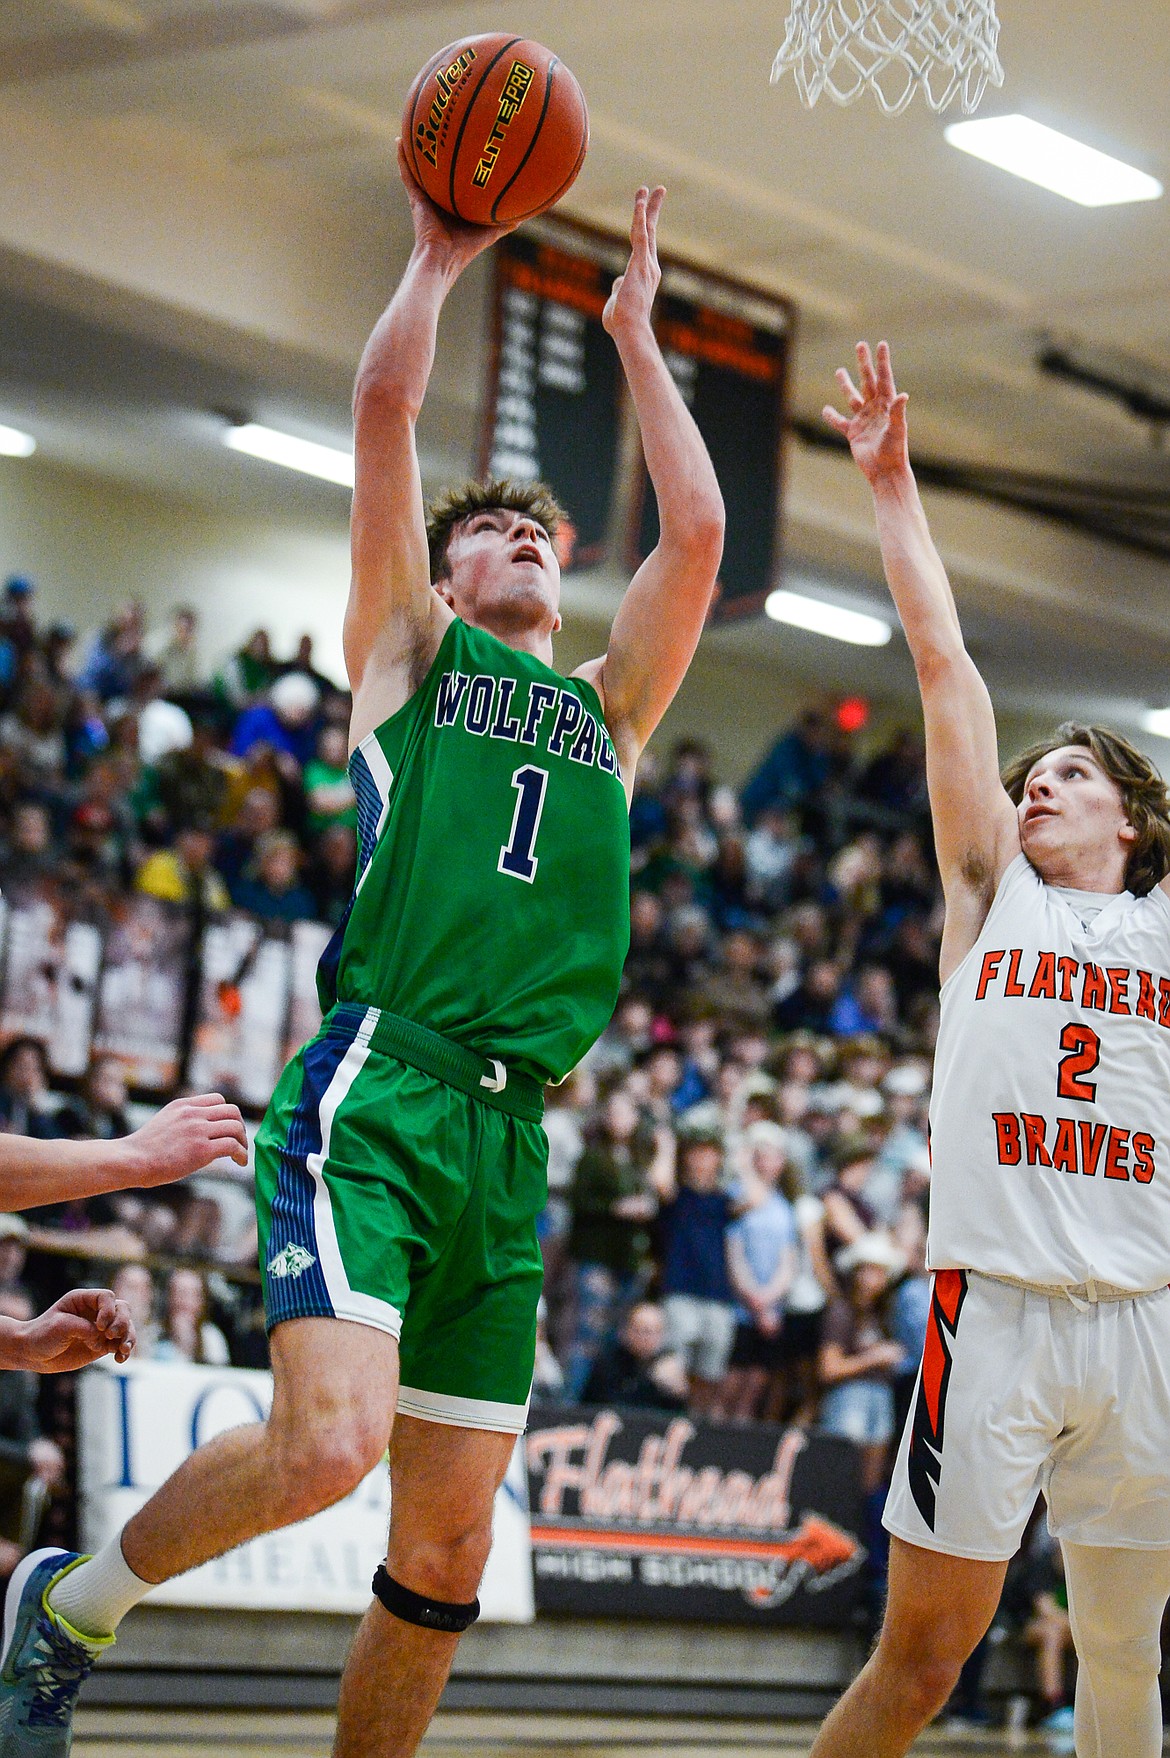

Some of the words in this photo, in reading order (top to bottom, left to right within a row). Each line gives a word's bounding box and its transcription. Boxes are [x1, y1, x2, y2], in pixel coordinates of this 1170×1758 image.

[416, 48, 478, 169] Baden
[434, 669, 624, 787] WOLFPAC
[497, 764, 549, 884] 1
[1057, 1022, 1101, 1103] 2
[992, 1112, 1156, 1184] BRAVES
[213, 1537, 387, 1592] HEAL
